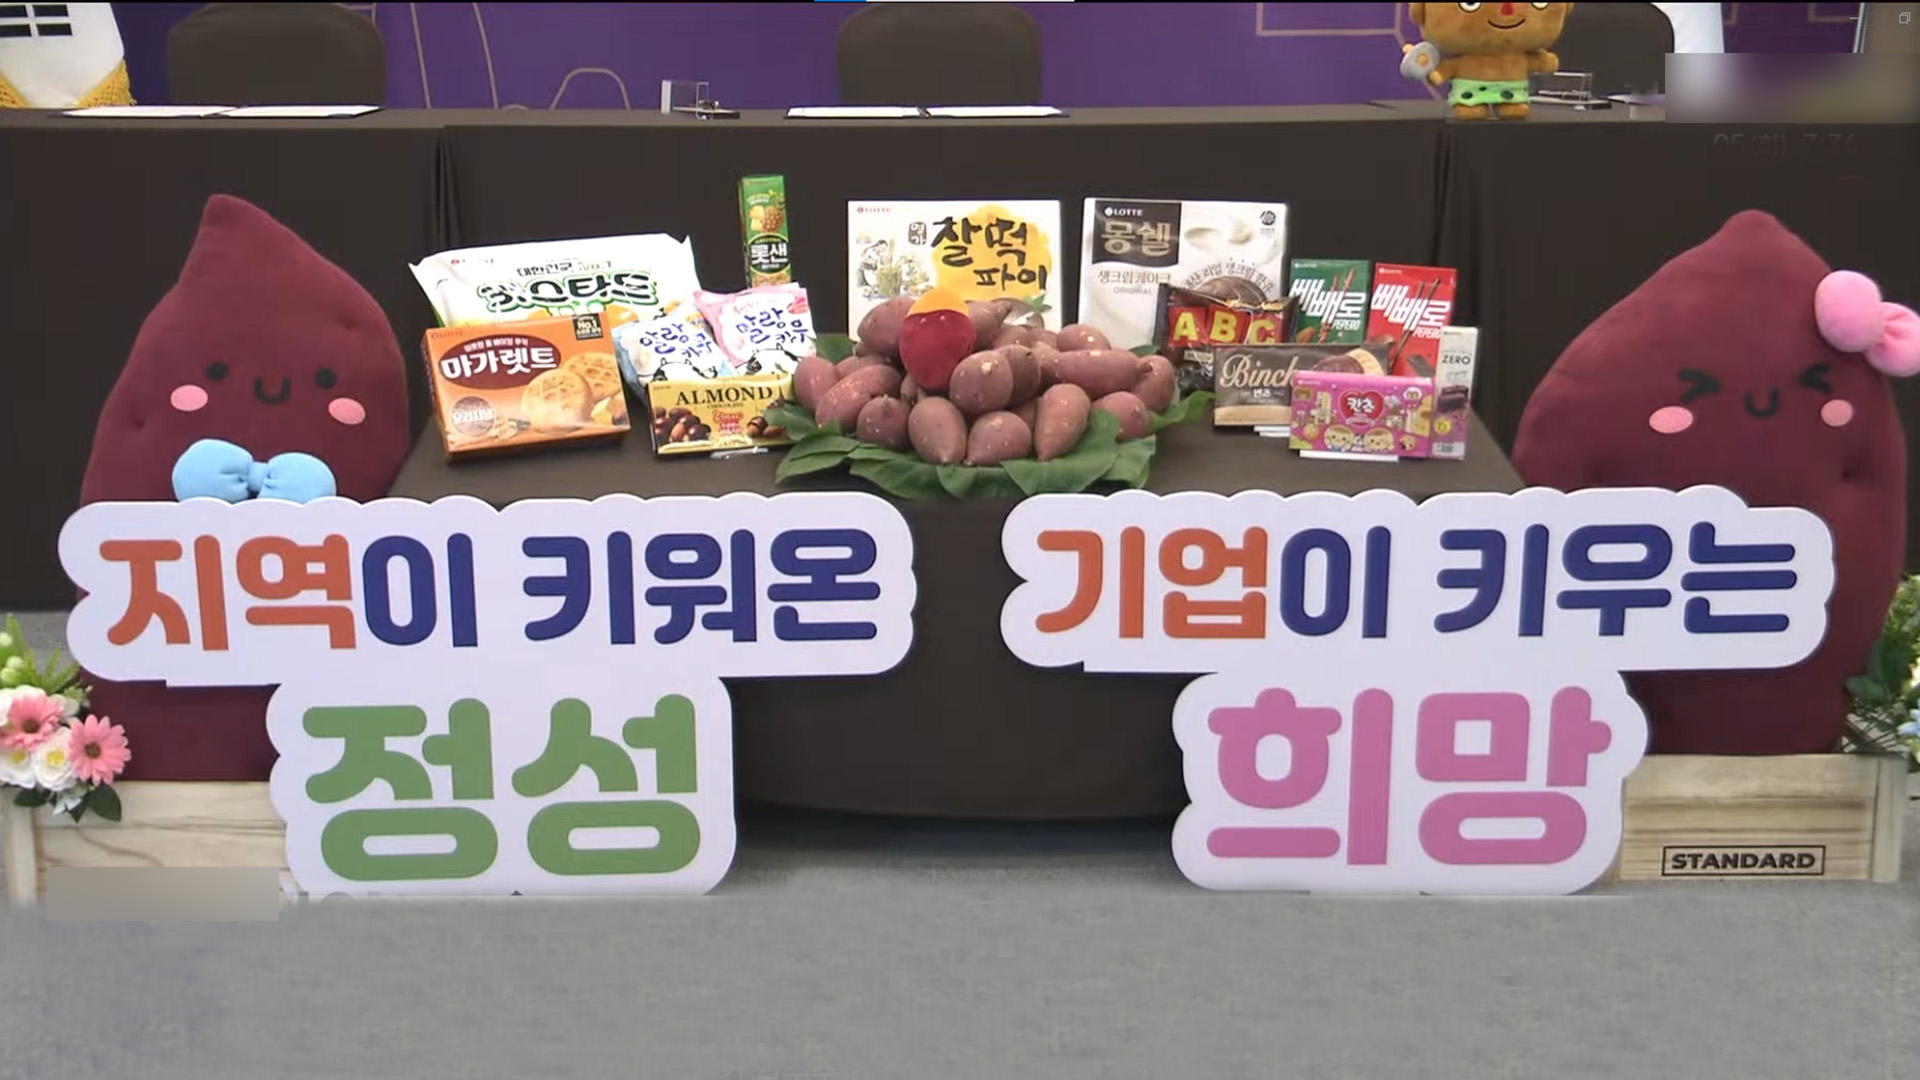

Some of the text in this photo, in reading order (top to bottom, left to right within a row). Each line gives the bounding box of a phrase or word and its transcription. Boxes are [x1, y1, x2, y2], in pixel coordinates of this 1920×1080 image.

[1113, 208, 1143, 216] LOTTE
[750, 243, 788, 265] 롯샌
[931, 216, 1028, 267] 찰떡
[1101, 219, 1171, 257] 몽쉘
[973, 263, 1048, 291] 파이
[1290, 279, 1366, 324] 빼빼로
[1370, 284, 1451, 331] 빼빼로
[736, 308, 786, 344] 말랑
[1172, 310, 1276, 345] ABC
[1332, 319, 1361, 331] PEPERO
[440, 347, 557, 380] 마가렛트
[1441, 354, 1471, 366] ZERO
[675, 387, 773, 406] ALMOND
[452, 408, 494, 424] 오리지널
[98, 528, 882, 653] 지역이 키워온
[1035, 520, 1798, 640] 기업이 키우는
[301, 693, 702, 882] 정성
[1206, 685, 1613, 866] 희망
[1671, 849, 1817, 870] STANDARD
